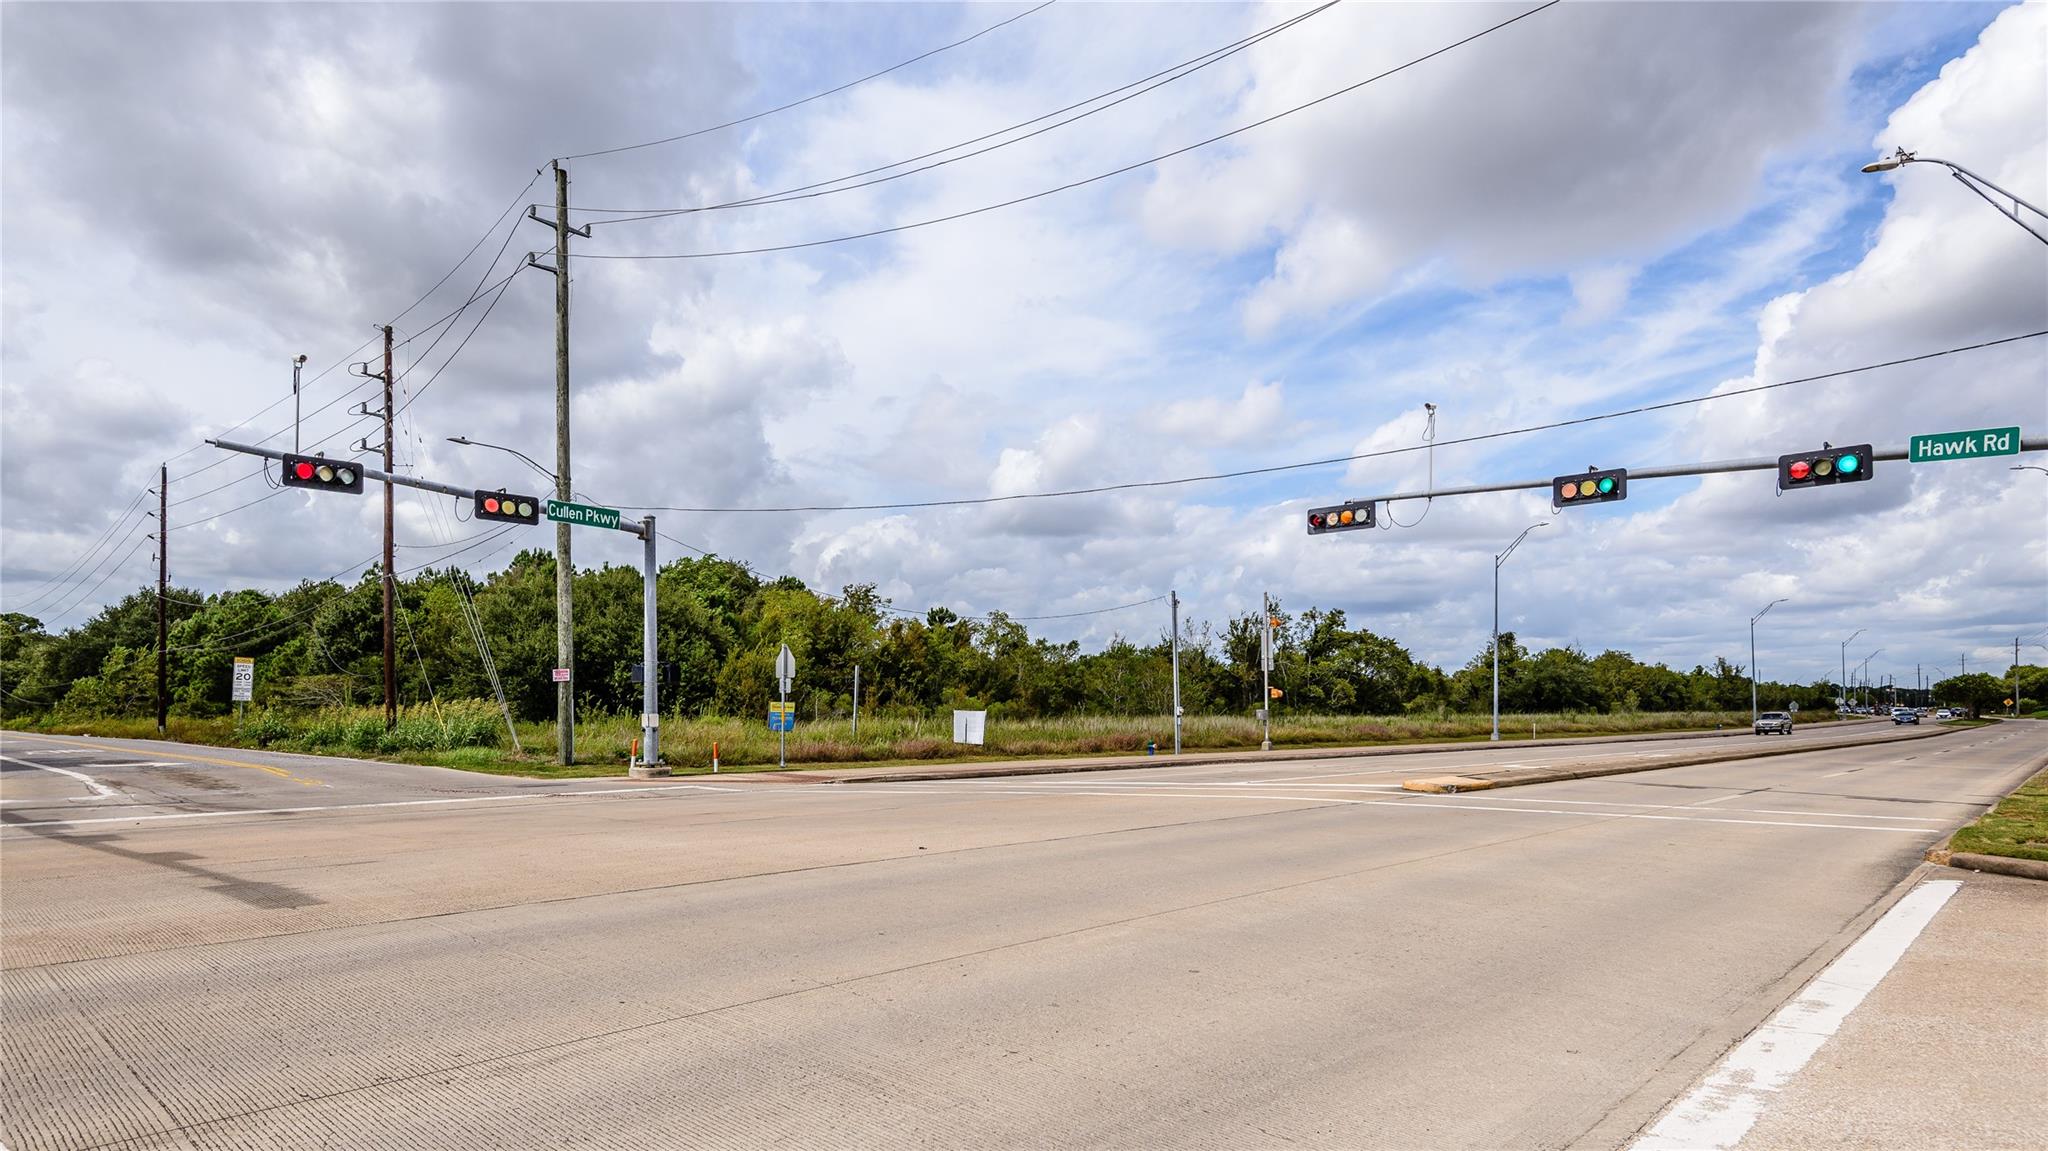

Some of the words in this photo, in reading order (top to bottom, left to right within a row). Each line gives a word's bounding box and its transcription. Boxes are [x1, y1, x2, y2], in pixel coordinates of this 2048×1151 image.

[1919, 436, 1978, 457] Hawk
[1983, 433, 2010, 452] Rd
[548, 503, 583, 520] Cullen
[586, 509, 619, 528] Pkwy
[236, 673, 251, 681] 20
